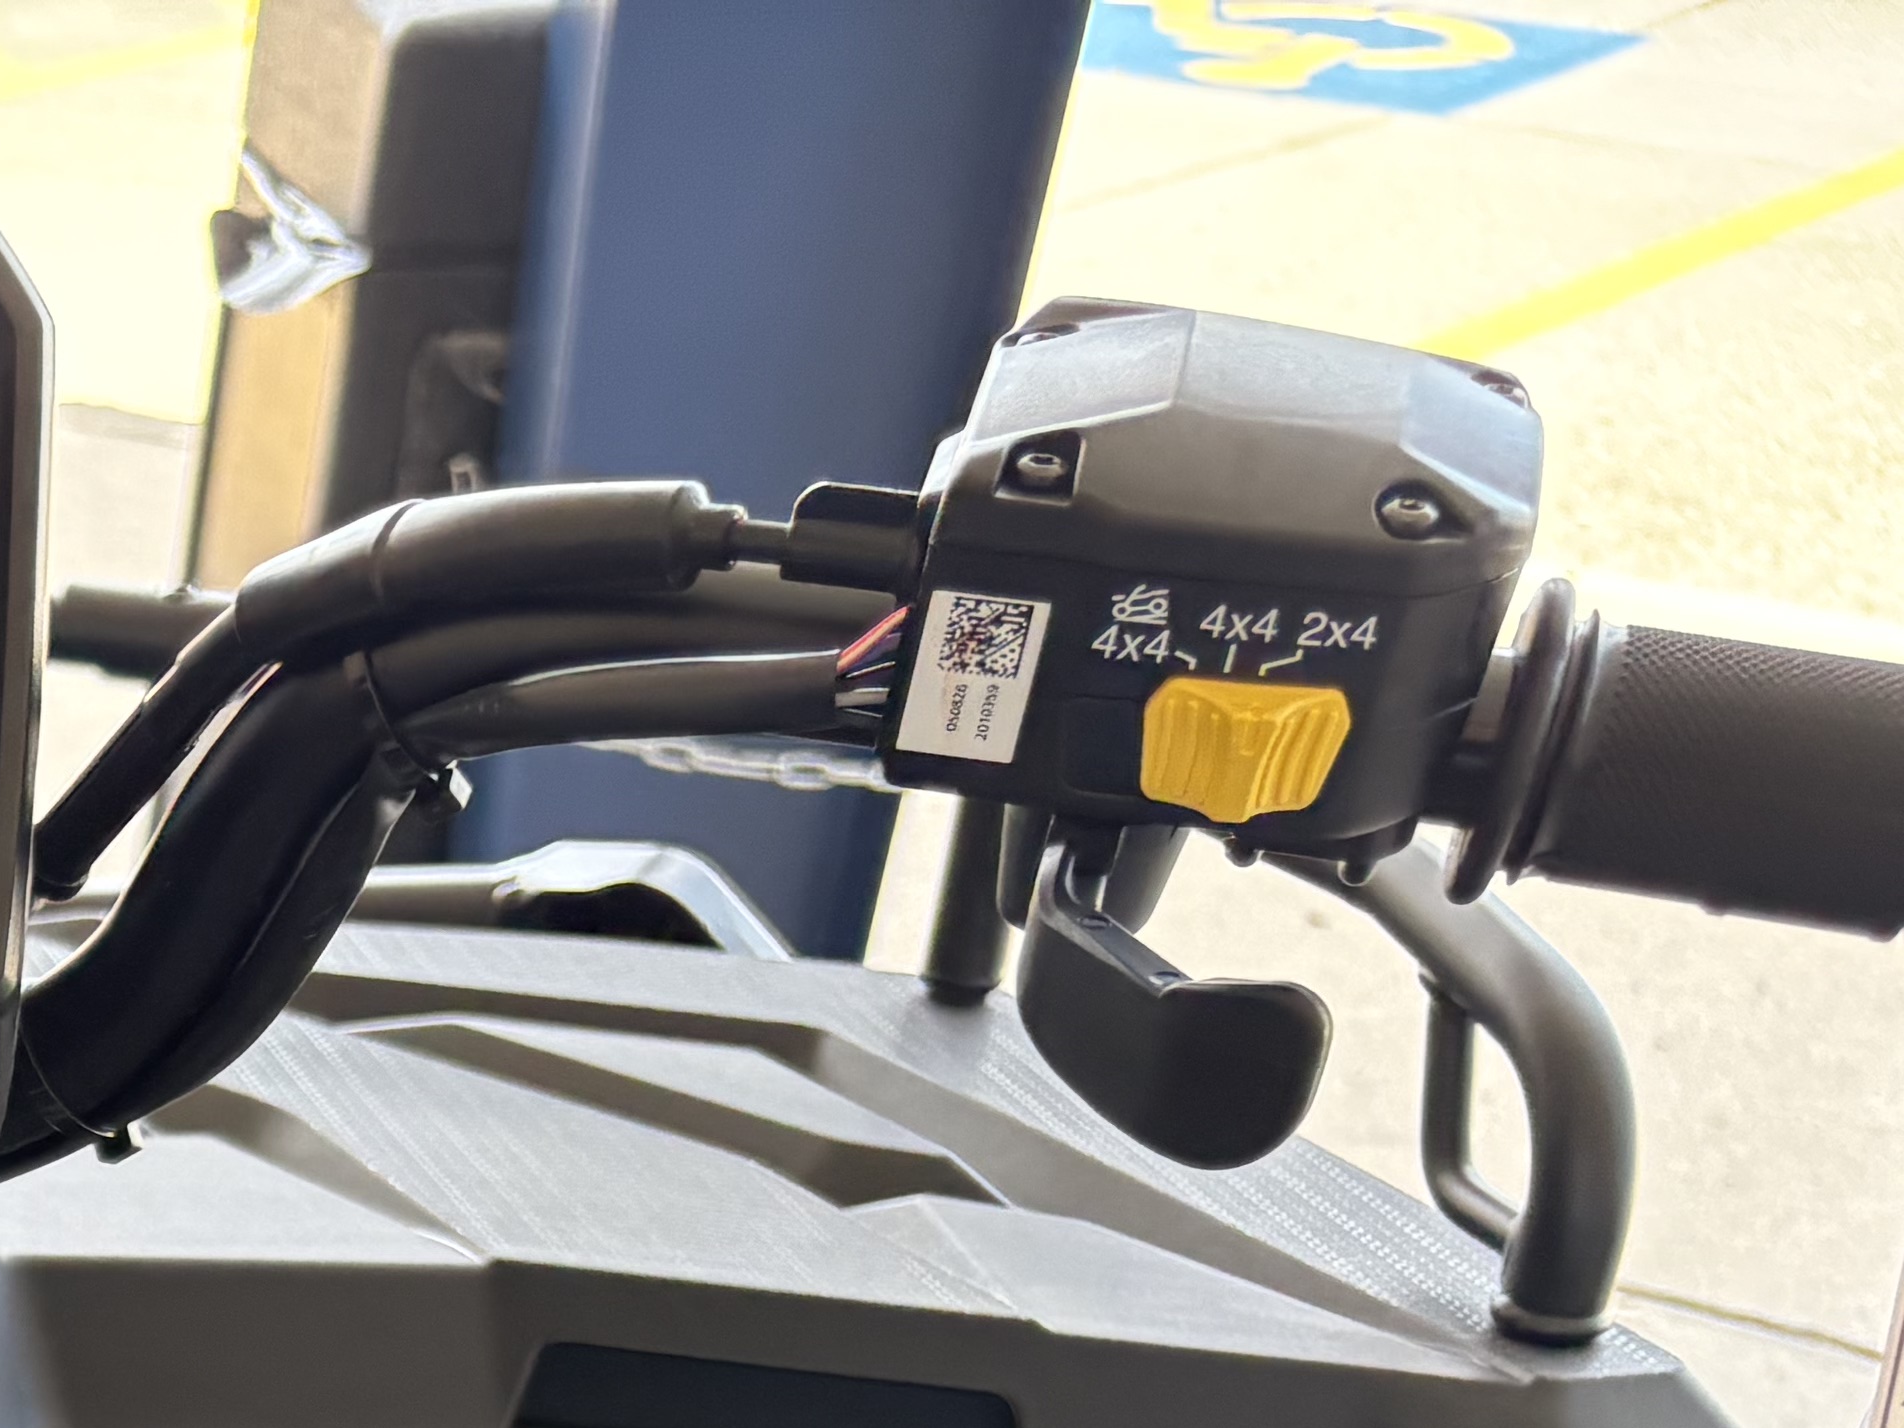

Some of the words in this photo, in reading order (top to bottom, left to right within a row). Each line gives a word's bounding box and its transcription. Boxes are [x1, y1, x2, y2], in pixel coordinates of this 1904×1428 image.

[1200, 604, 1280, 643] 4x4
[1297, 612, 1378, 650] 2x4
[1092, 624, 1170, 663] 4x4
